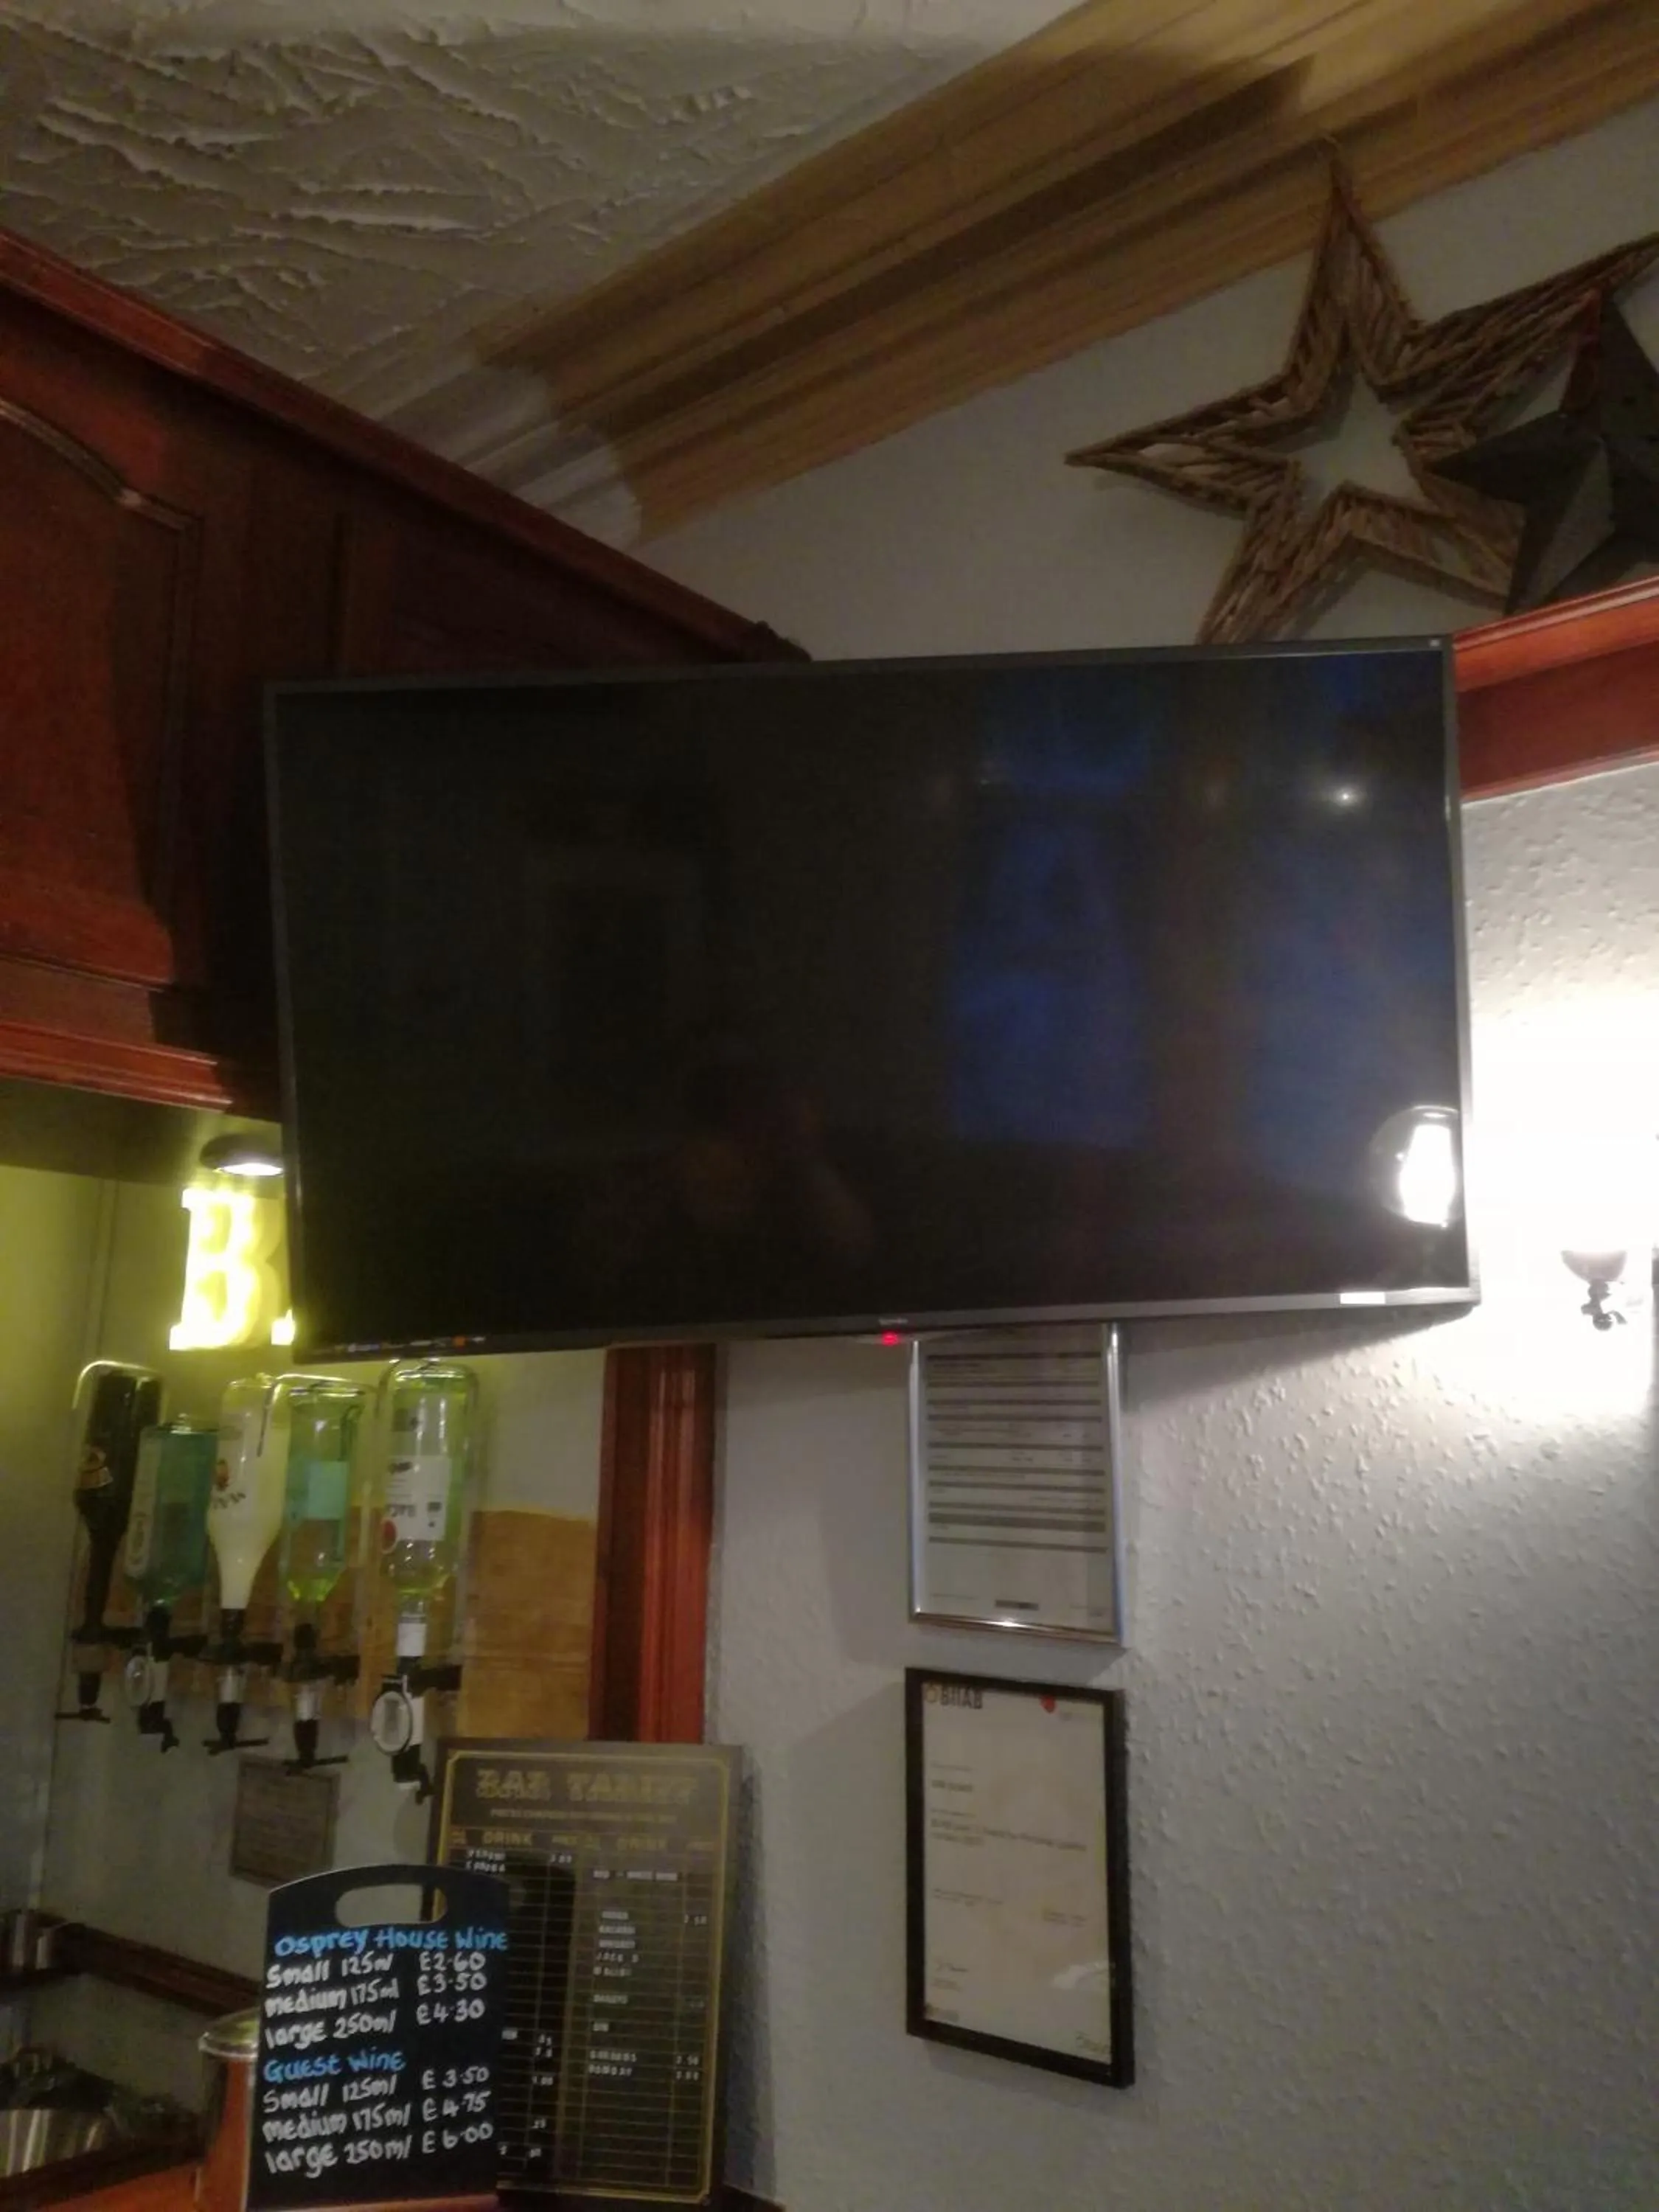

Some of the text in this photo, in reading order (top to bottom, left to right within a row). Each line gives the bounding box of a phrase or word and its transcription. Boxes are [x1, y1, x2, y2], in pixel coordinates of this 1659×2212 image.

[274, 1928, 369, 1958] Osprey
[332, 2009, 397, 2039] 250ml
[342, 2074, 397, 2102] 125ml
[352, 2102, 412, 2132] 175ml
